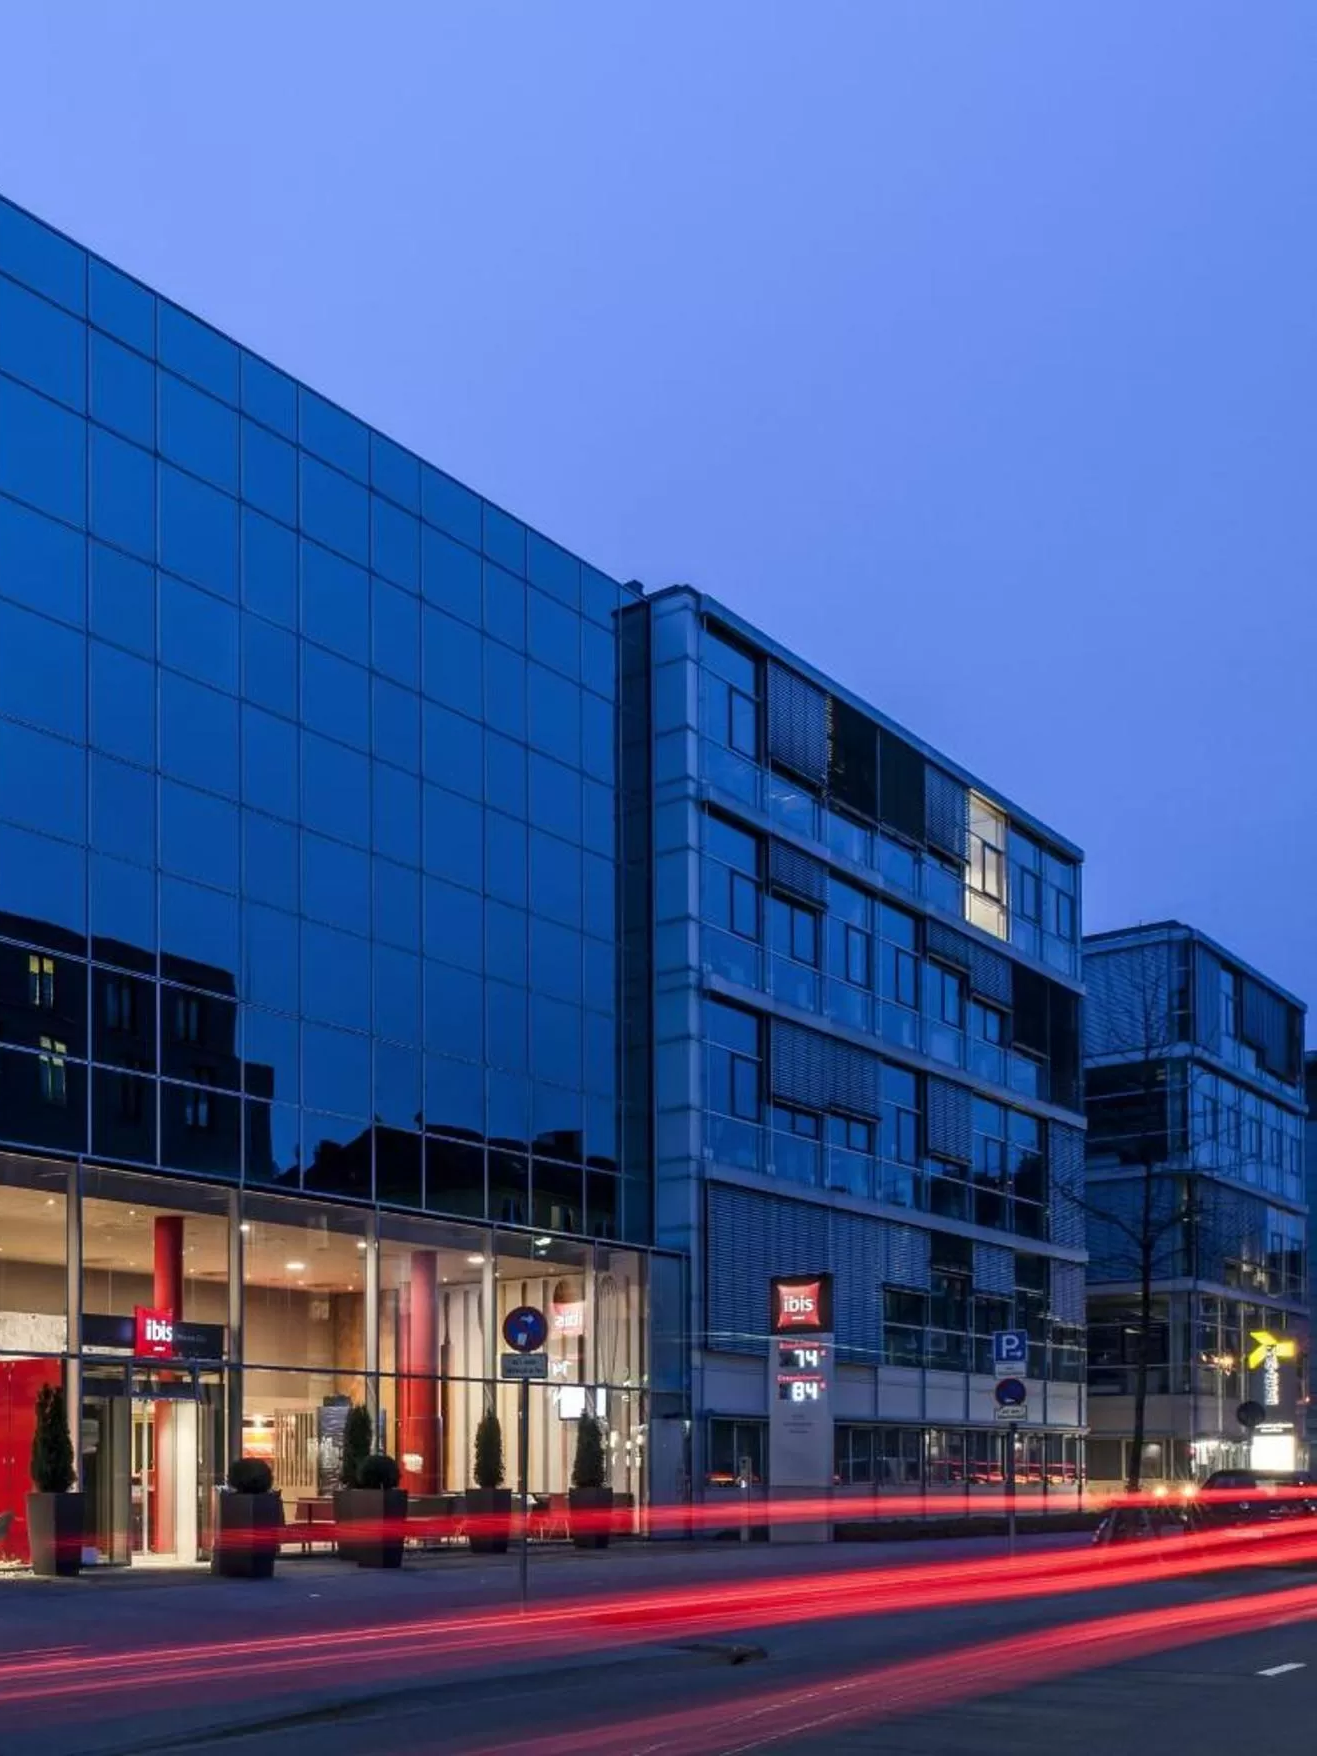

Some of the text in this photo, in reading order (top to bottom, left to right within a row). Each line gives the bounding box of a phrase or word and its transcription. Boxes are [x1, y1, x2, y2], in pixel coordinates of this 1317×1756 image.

[783, 1295, 814, 1313] ibis
[145, 1318, 173, 1342] ibis
[1002, 1335, 1020, 1359] P
[792, 1382, 818, 1402] 84
